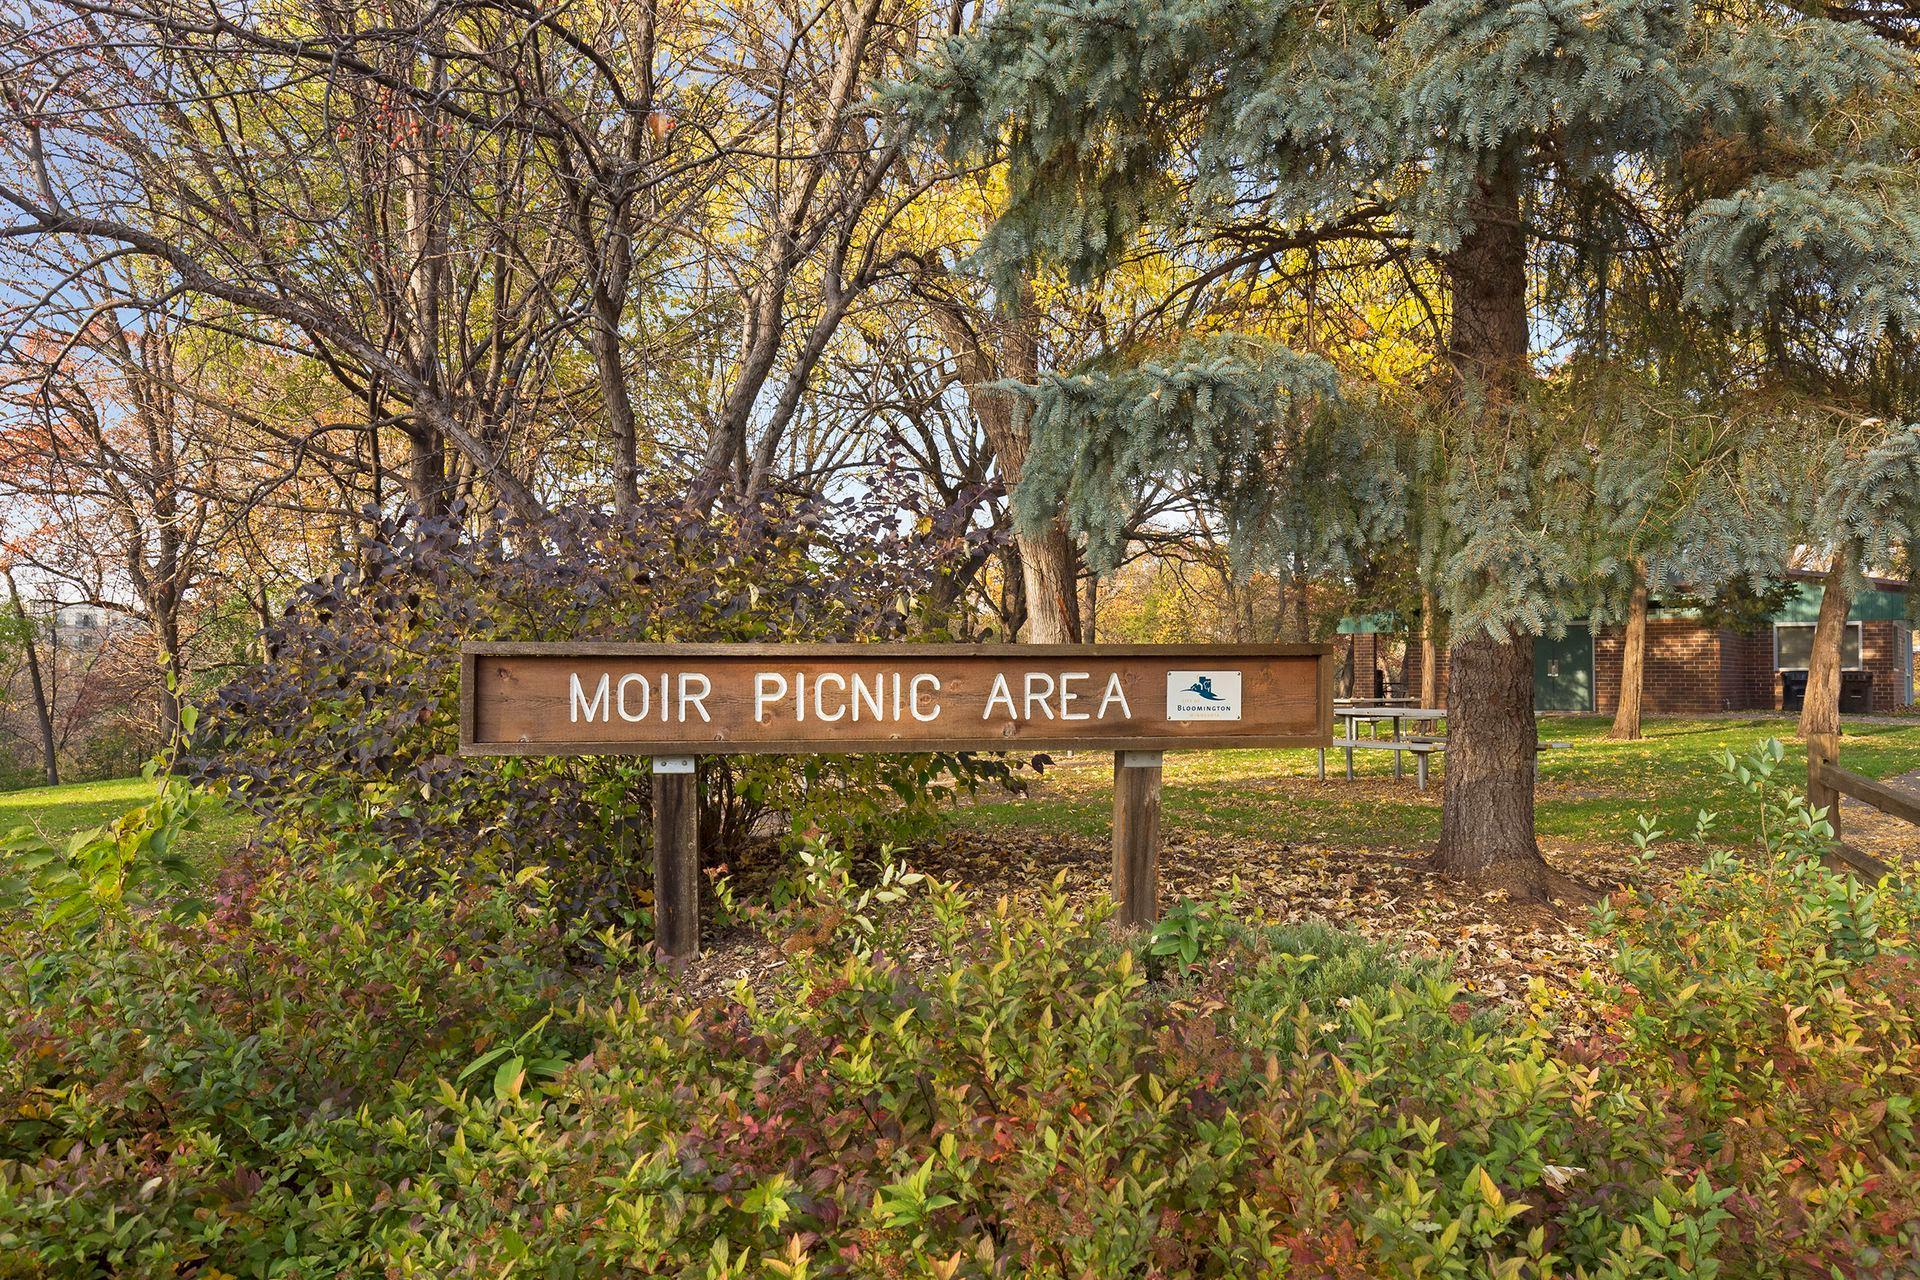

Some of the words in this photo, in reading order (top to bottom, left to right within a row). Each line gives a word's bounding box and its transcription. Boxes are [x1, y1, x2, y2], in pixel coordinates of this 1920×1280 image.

[569, 672, 712, 723] MOIR
[754, 672, 941, 722] PICNIC
[982, 672, 1132, 721] AREA
[1177, 704, 1231, 712] BLOOMINGTON
